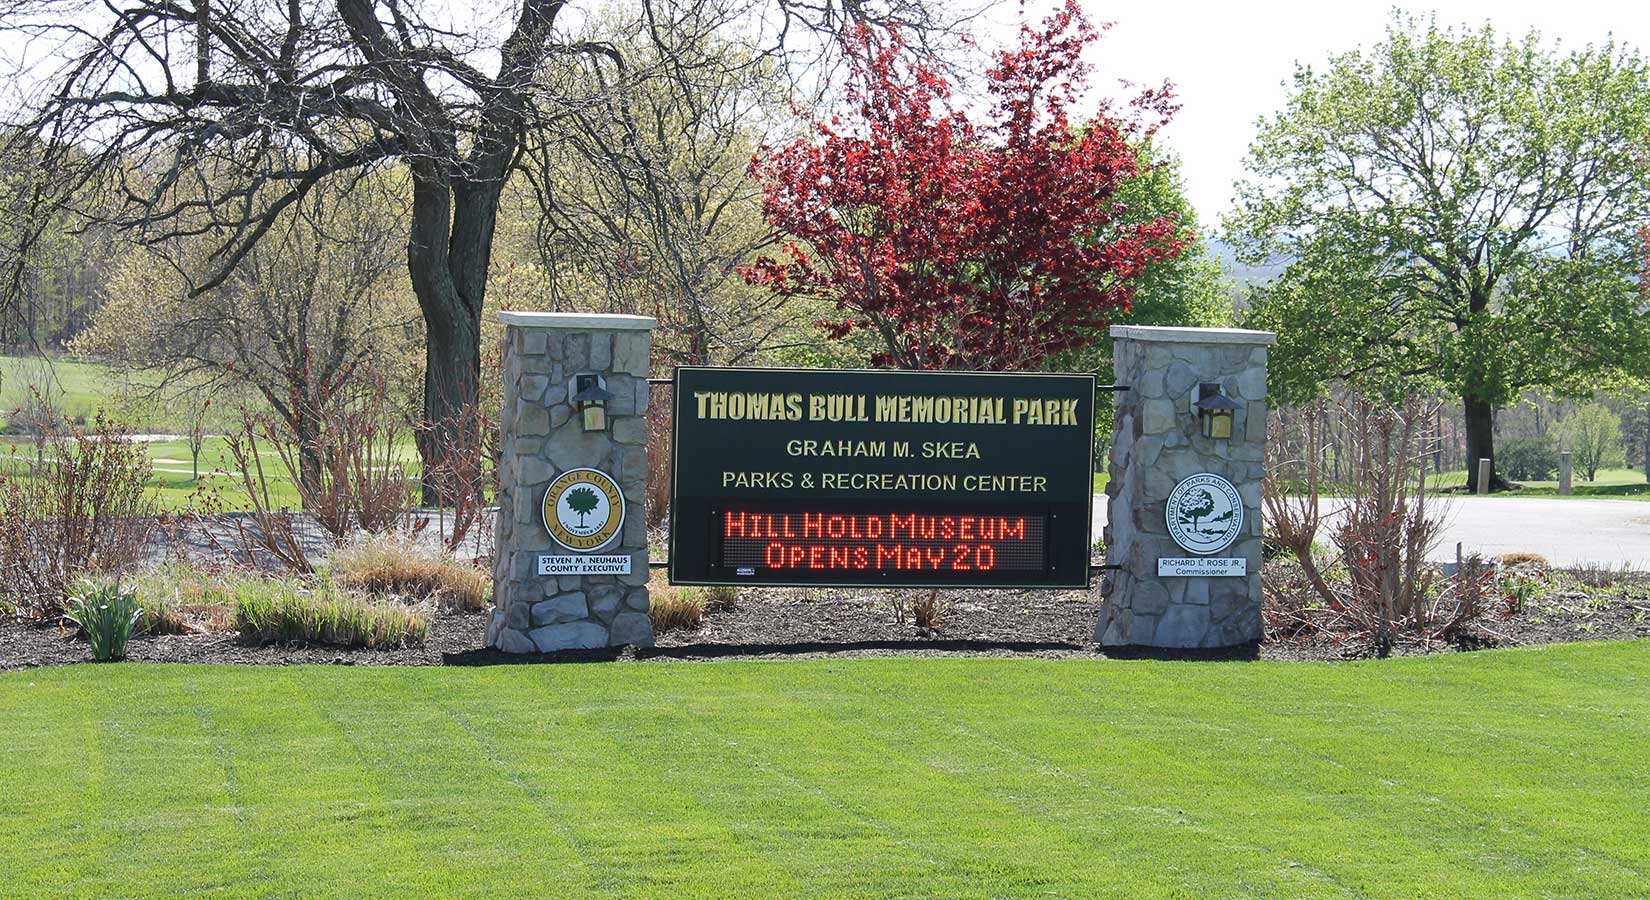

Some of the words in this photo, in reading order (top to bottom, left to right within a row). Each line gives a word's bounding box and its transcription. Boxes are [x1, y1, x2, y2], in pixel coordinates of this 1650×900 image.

[694, 391, 803, 422] THOMAS
[809, 393, 869, 422] BULL
[875, 394, 1007, 425] MEMORIAL
[1013, 397, 1079, 426] PARK
[786, 439, 886, 458] GRAHAM
[893, 440, 915, 458] M.
[922, 441, 981, 460] SKEA
[547, 471, 584, 508] ORANGE
[586, 472, 620, 508] COUNTY
[722, 471, 794, 489] PARKS
[801, 472, 815, 490] &
[822, 472, 957, 491] RECREATION
[963, 475, 1047, 492] CENTER
[1177, 486, 1186, 495] OF
[1186, 477, 1211, 488] PARKS
[1211, 478, 1226, 490] AND
[725, 510, 797, 538] HILL
[803, 512, 884, 539] HOLD
[889, 513, 1026, 541] MUSEUM
[1169, 495, 1188, 543] DEPARTMENT
[1222, 488, 1241, 542] CONSERVATION
[551, 523, 574, 546] NEW
[578, 528, 611, 548] YORK
[766, 541, 869, 570] OPENS
[876, 543, 947, 570] MAY
[951, 544, 996, 571] 20
[1162, 559, 1196, 567] RICHARD
[1207, 559, 1228, 567] ROSE
[1231, 559, 1241, 567] JR.
[1175, 568, 1228, 576] Commissioner
